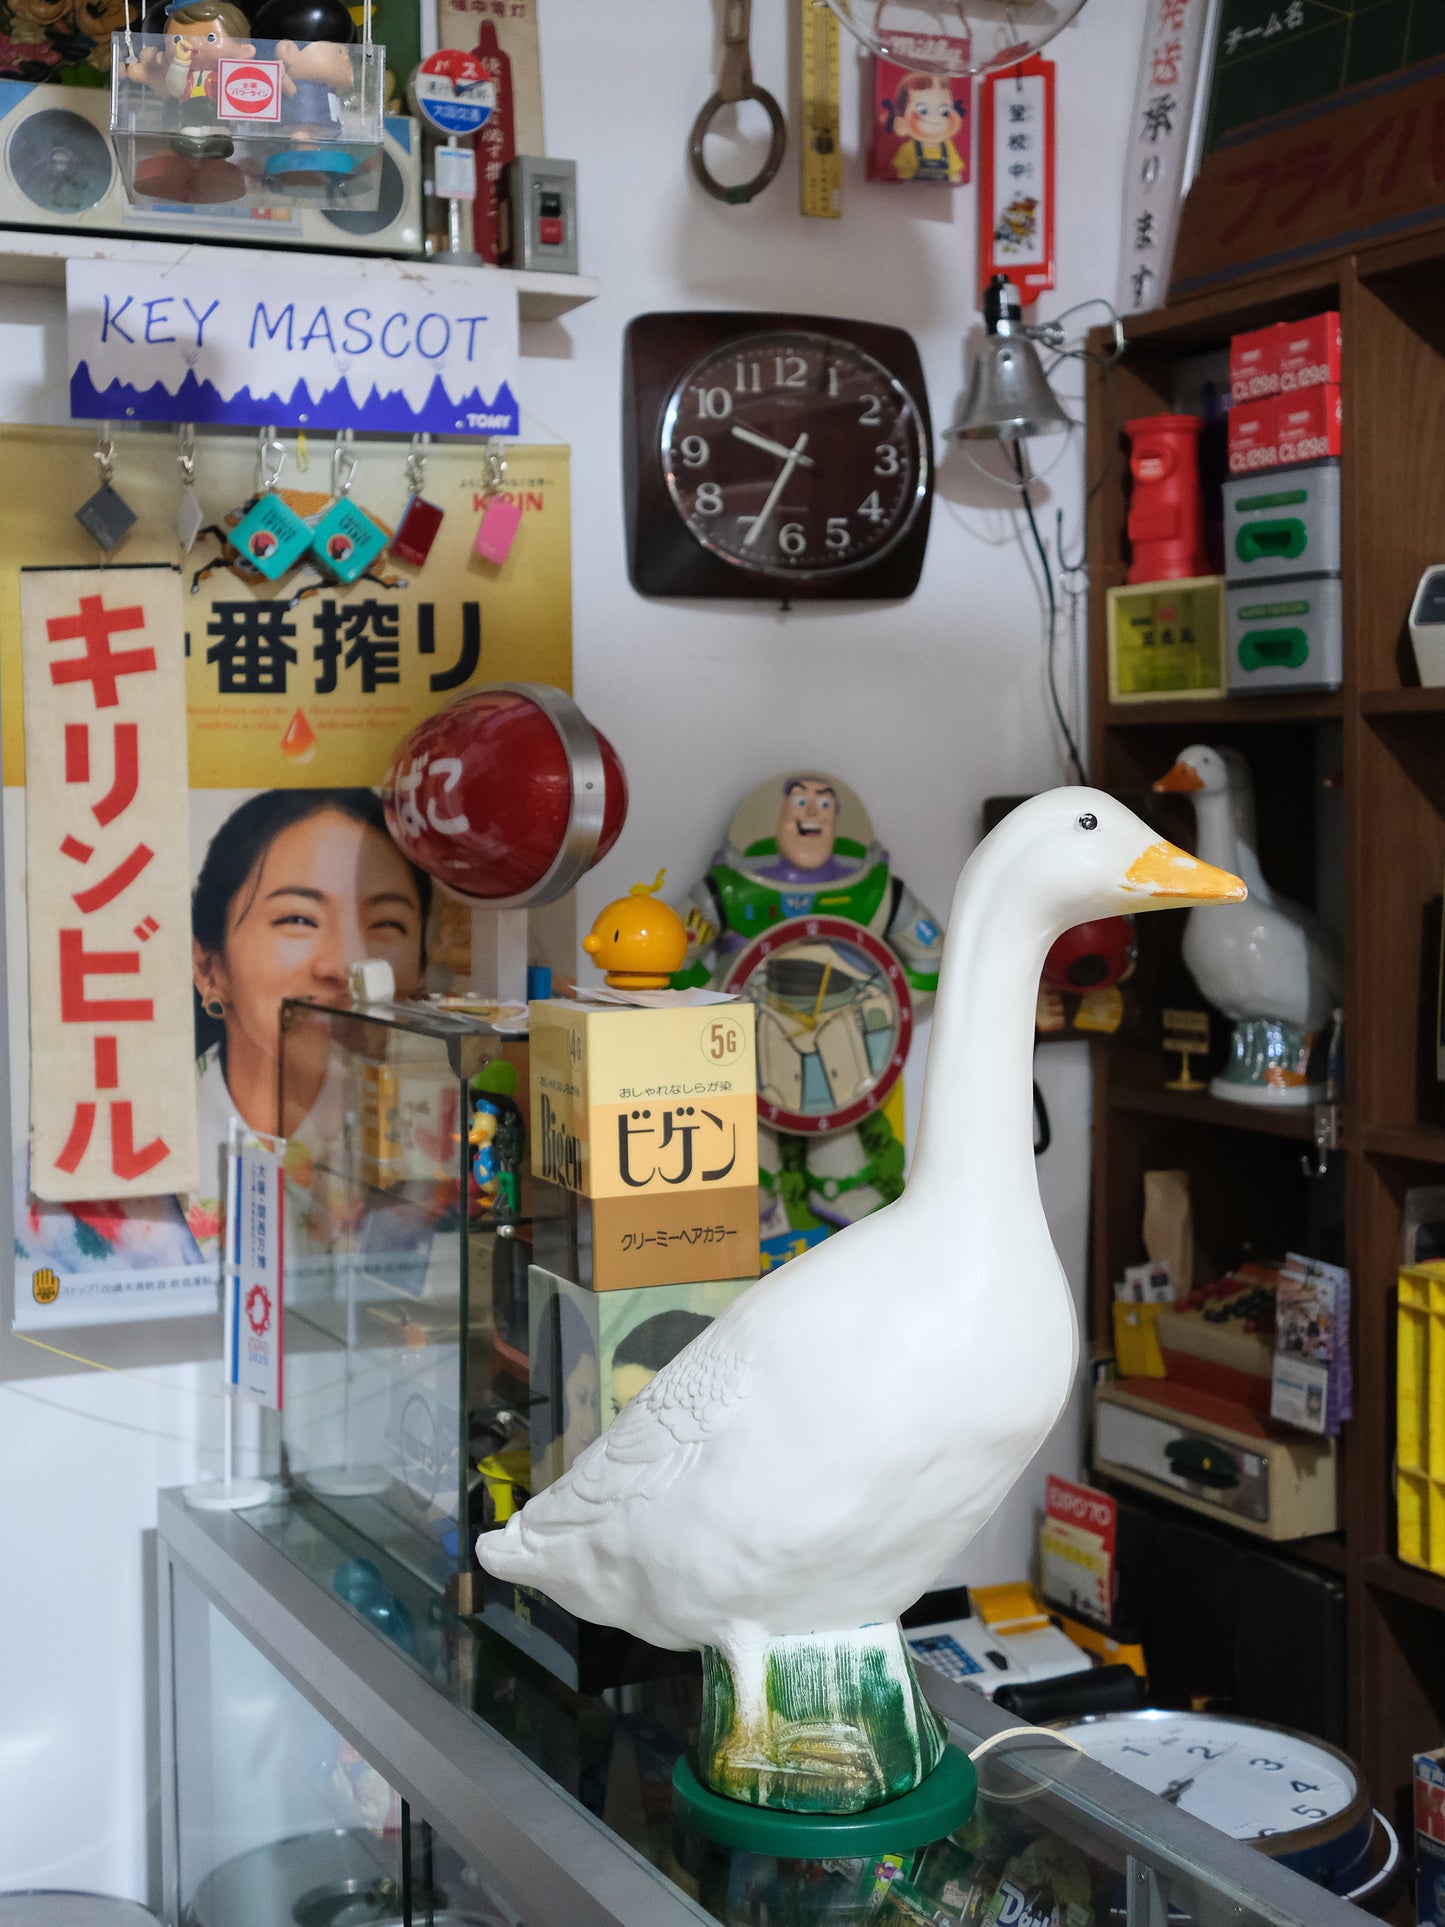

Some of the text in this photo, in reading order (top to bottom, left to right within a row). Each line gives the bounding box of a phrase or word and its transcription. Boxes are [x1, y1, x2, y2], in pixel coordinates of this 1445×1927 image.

[231, 88, 268, 97] パワーライン
[99, 294, 489, 362] KEY MASCOT
[735, 361, 761, 393] 11
[774, 356, 809, 388] 12
[828, 367, 839, 398] 1
[696, 387, 732, 419] 10
[858, 394, 882, 426] 2
[466, 412, 512, 429] TOMY
[680, 435, 710, 468] 9
[874, 444, 900, 477] 3
[472, 492, 544, 513] KRIN
[694, 482, 724, 516] 8
[857, 490, 884, 522] 4
[779, 523, 807, 554] 6
[825, 518, 850, 549] 5
[186, 600, 481, 694] 番搾り
[388, 751, 470, 838] ばこ
[46, 594, 170, 1181] キリンビール
[710, 1024, 737, 1059] 5G
[619, 1080, 732, 1098] おしゃれなしらが染
[540, 1093, 583, 1191] Bigen
[618, 1106, 736, 1187] ビゲン
[621, 1225, 738, 1251] クリーミーヘアカラー
[1121, 1745, 1149, 1757] 1
[1187, 1745, 1222, 1760] 2
[1249, 1758, 1285, 1771] 3
[1290, 1779, 1321, 1794] 4
[1291, 1804, 1328, 1819] 5
